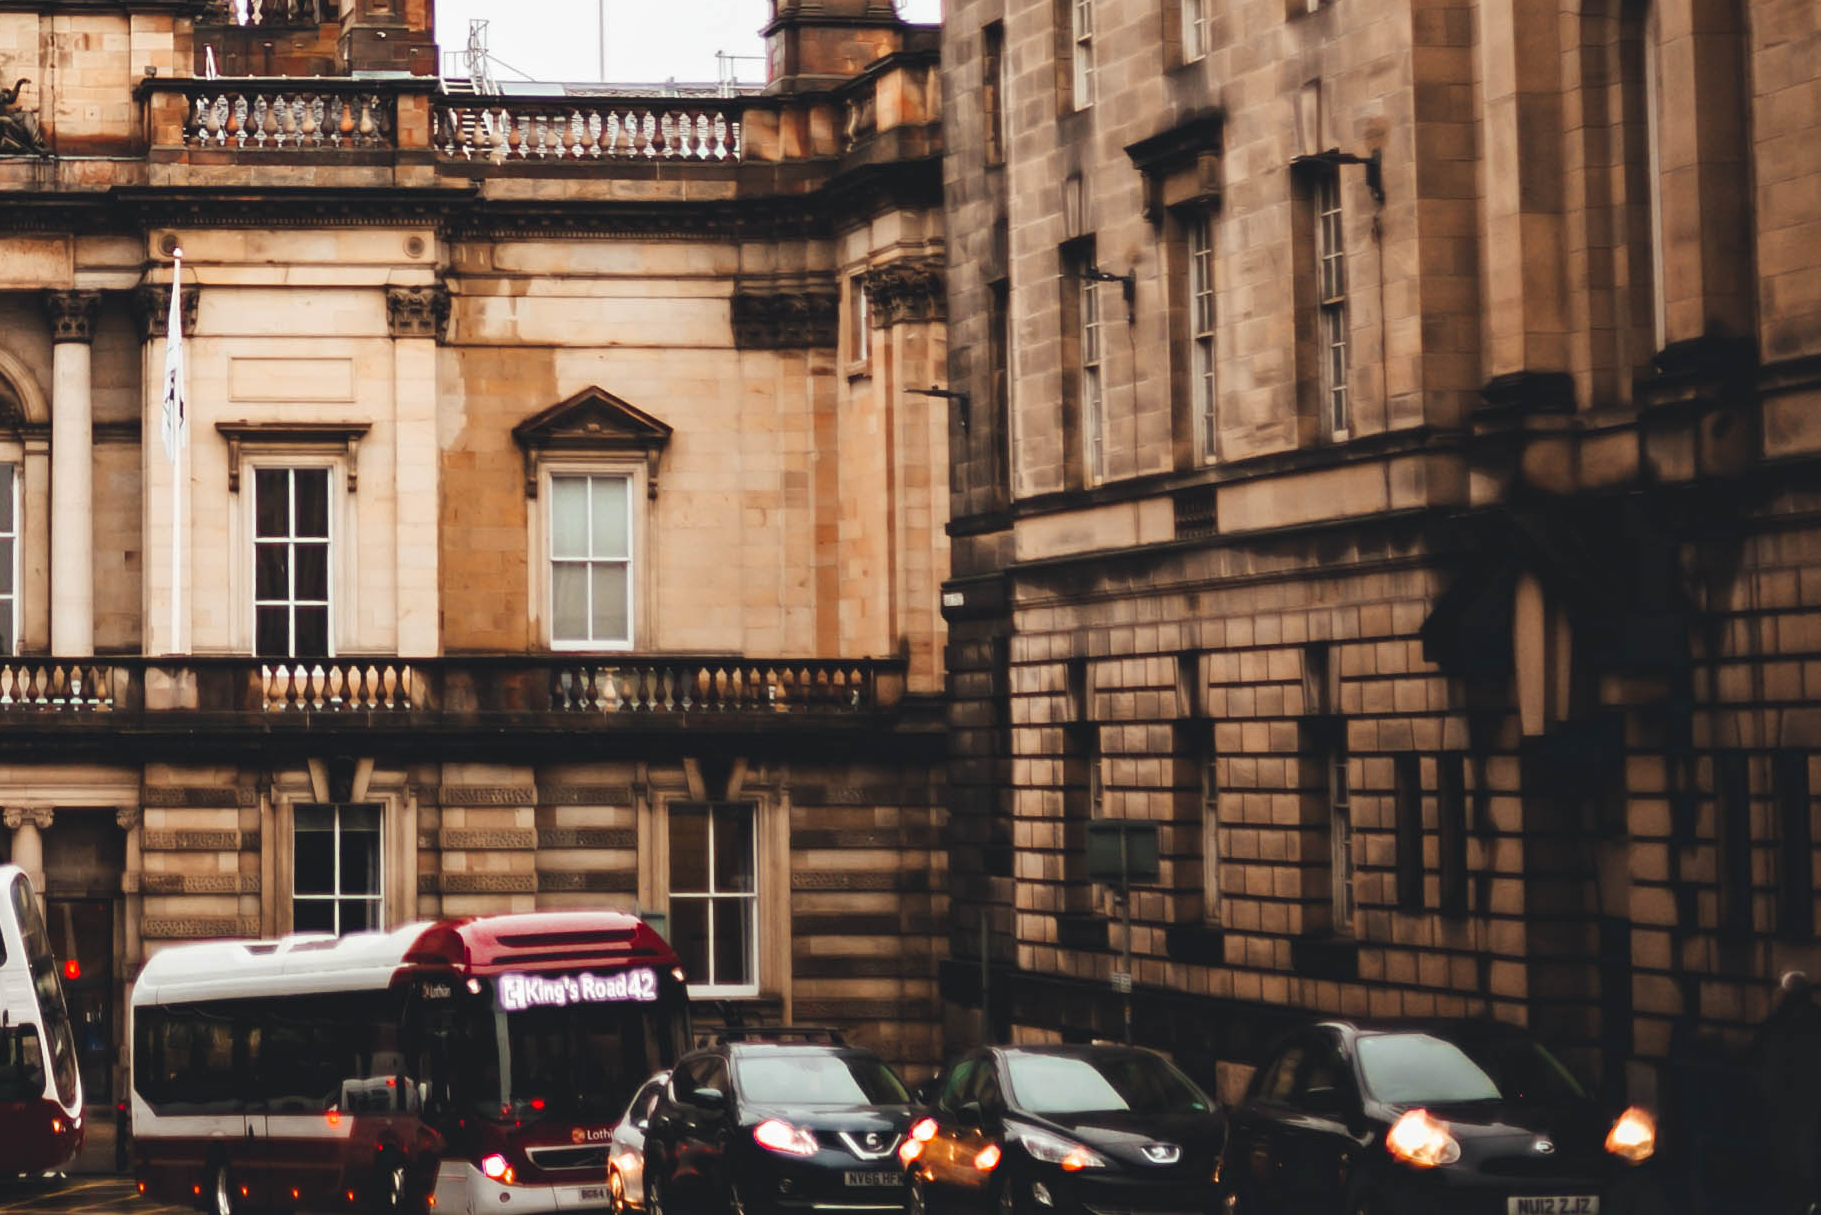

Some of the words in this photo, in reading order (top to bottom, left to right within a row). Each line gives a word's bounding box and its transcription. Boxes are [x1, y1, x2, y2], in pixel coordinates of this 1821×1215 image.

[526, 977, 578, 1006] King's
[580, 973, 627, 1000] Road
[628, 969, 656, 1000] 42
